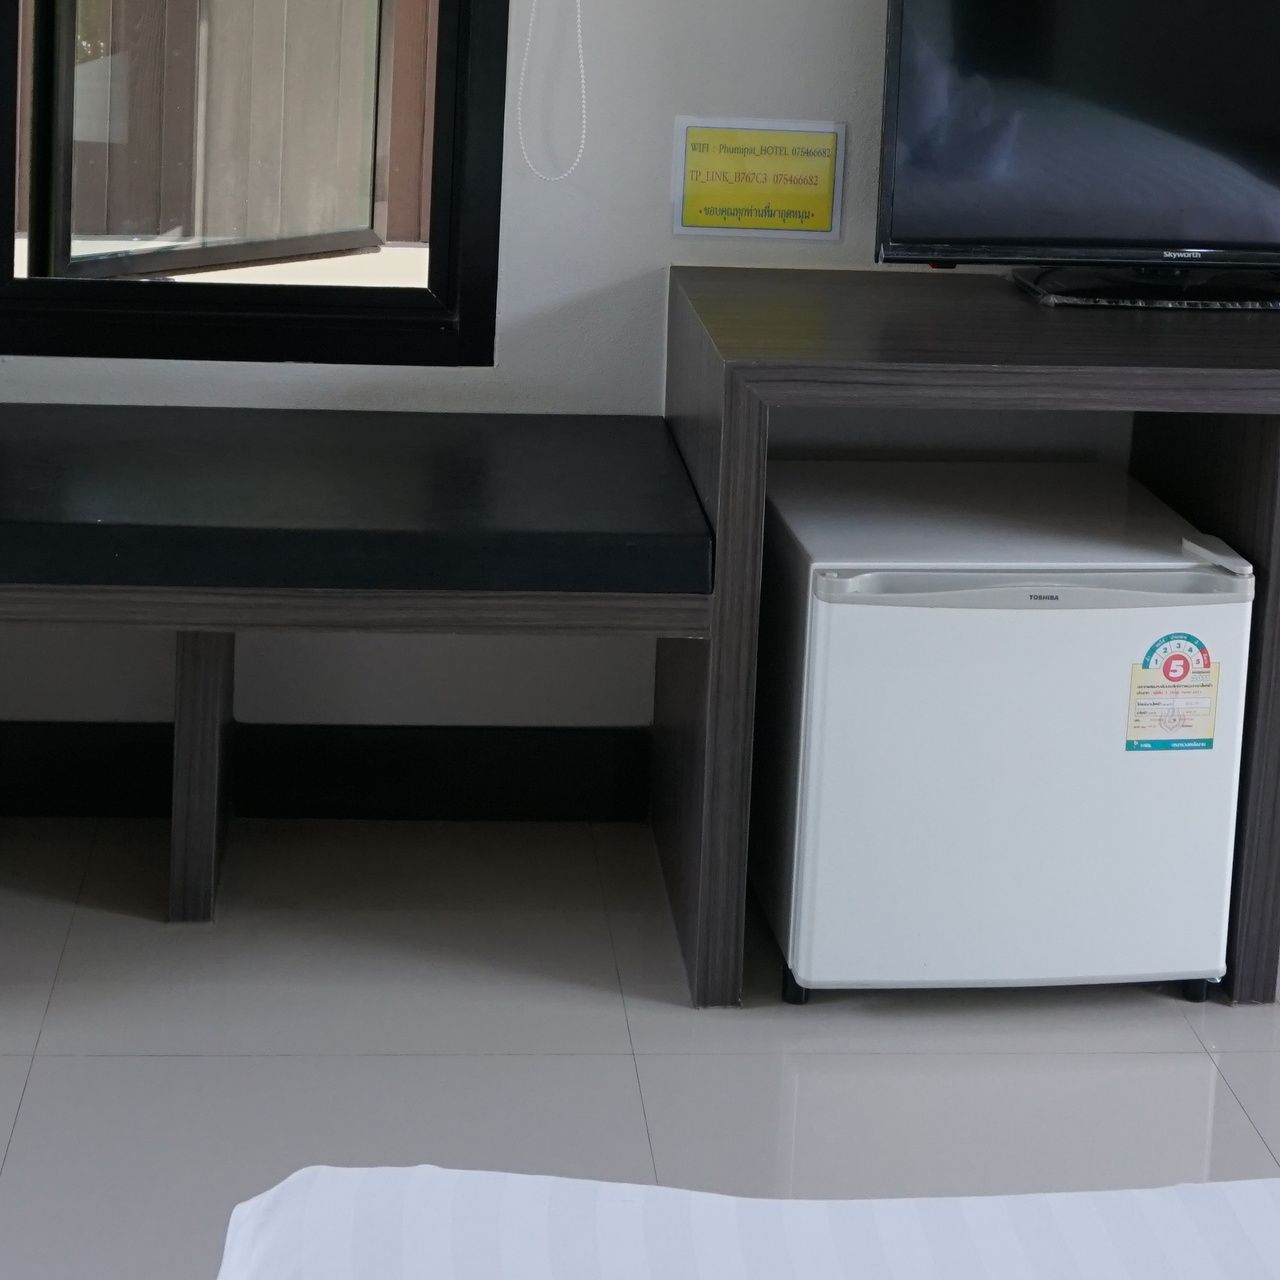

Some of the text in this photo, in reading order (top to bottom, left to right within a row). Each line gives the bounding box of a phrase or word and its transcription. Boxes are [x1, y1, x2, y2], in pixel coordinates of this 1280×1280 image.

[690, 143, 710, 153] WIFI
[1163, 251, 1202, 259] Skyworth
[1169, 659, 1185, 678] 5
